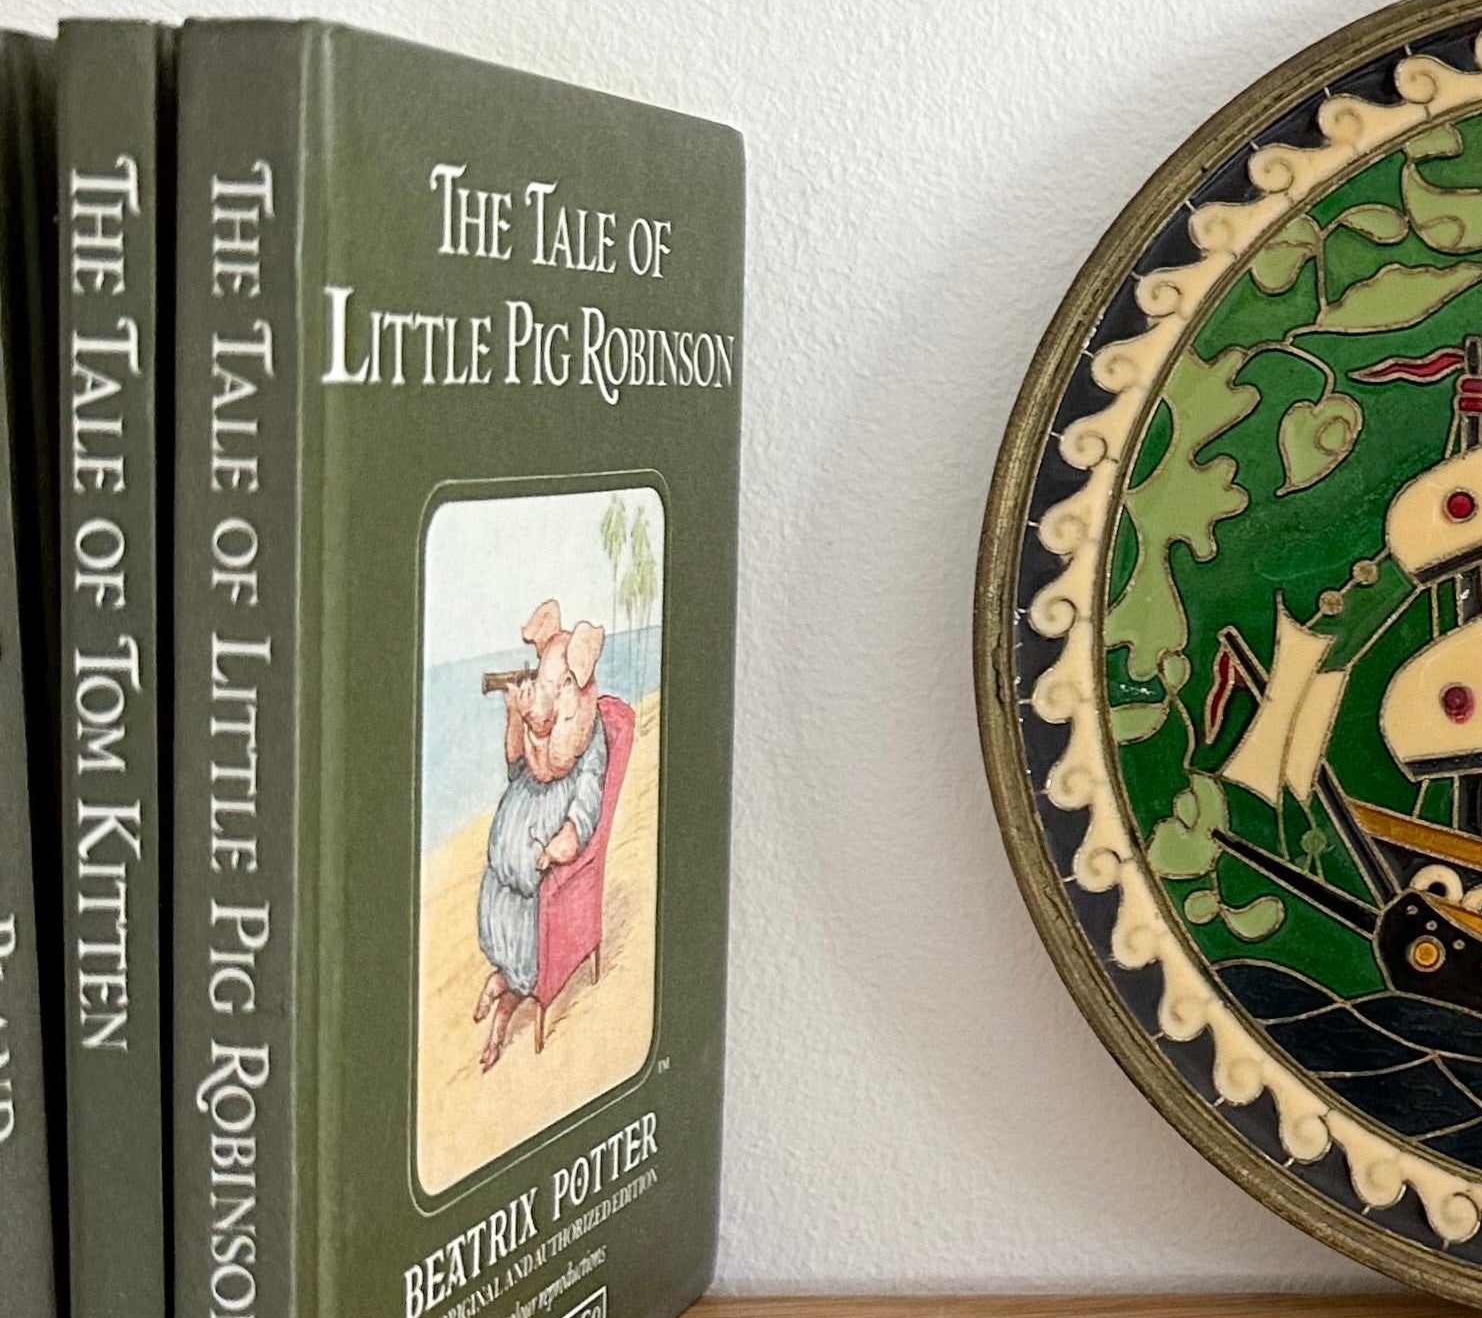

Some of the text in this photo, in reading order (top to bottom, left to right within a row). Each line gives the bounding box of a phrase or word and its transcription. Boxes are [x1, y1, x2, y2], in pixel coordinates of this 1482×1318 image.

[211, 158, 275, 298] THE
[430, 162, 671, 278] THE TALE OF
[321, 284, 735, 405] LITTLE PIG ROBINSON
[211, 318, 275, 494] TALE
[71, 154, 142, 1053] THE TALE OF TOM KITTEN
[211, 517, 259, 608] OF
[211, 631, 272, 873] LITTLE
[208, 898, 271, 1014] PIG
[552, 1111, 658, 1222] POTTER
[504, 1253, 534, 1291] AND
[532, 1199, 611, 1270] AUTHORIZED
[611, 1165, 659, 1214] EDITION
[538, 1245, 607, 1312] reproductions
